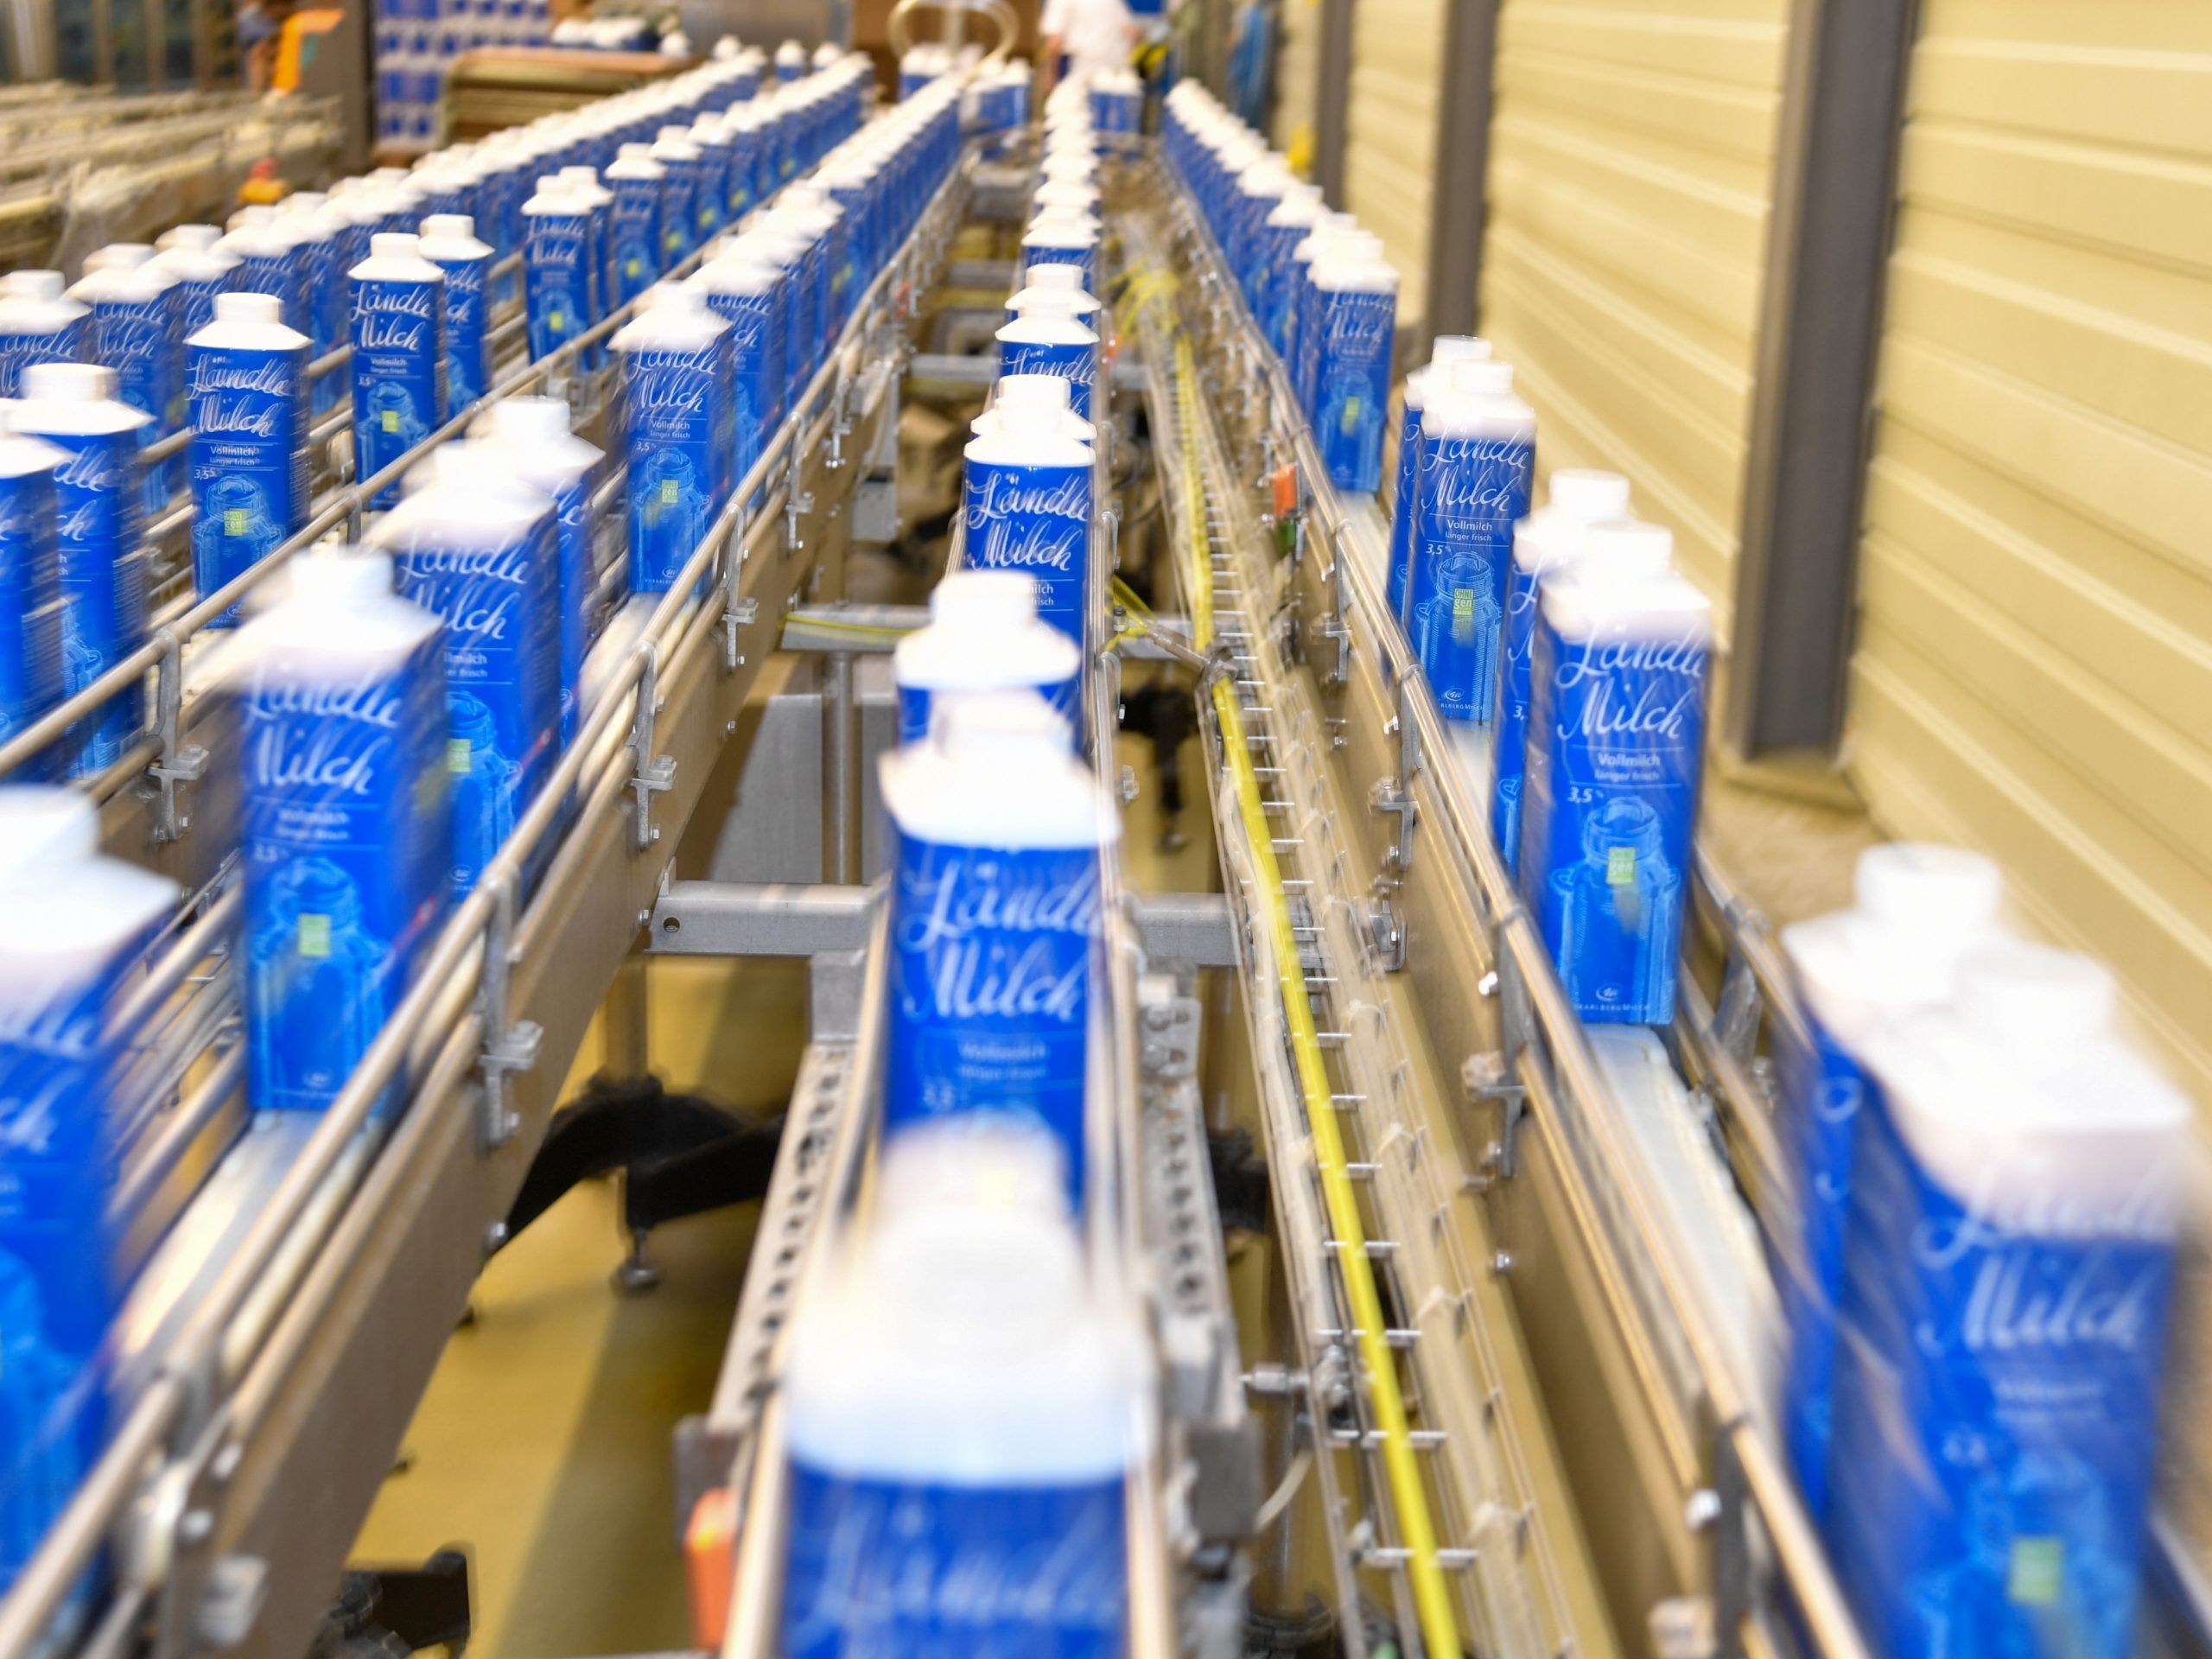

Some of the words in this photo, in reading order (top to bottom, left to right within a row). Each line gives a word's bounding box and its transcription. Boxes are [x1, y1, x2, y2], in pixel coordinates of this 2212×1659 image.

[347, 282, 432, 322] Ländle
[359, 315, 426, 353] Milch
[630, 372, 713, 414] Milch
[651, 420, 690, 432] Vollmilch
[966, 470, 1092, 530] Ländle
[1421, 464, 1521, 512] Milch
[964, 516, 1084, 571] Milch
[1447, 518, 1492, 531] Vollmilch
[1471, 531, 1491, 541] frisch
[1453, 599, 1472, 610] gen
[1557, 677, 1696, 740] Milch
[1598, 753, 1661, 766] Vollmilch
